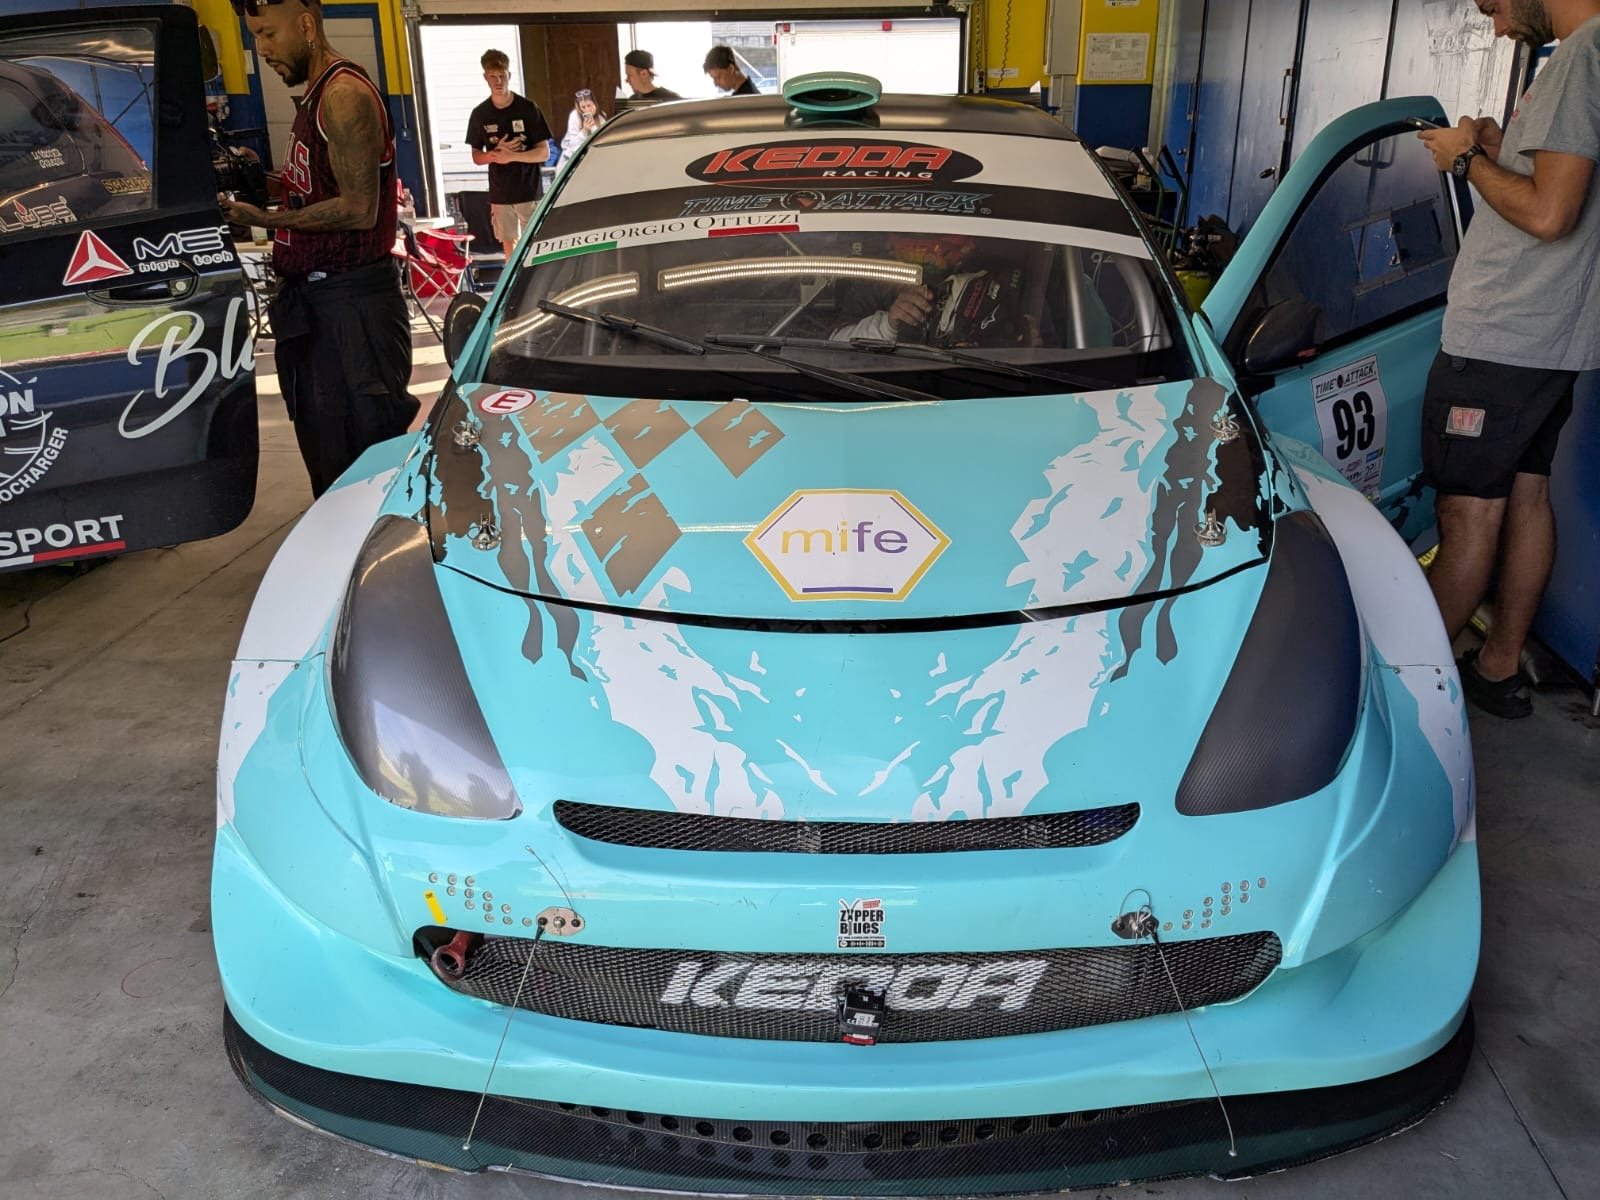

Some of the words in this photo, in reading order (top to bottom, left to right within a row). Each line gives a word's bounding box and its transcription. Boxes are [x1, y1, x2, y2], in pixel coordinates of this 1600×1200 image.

[702, 146, 952, 174] KEDDA
[822, 170, 933, 179] RACING
[679, 194, 785, 217] TIME
[820, 191, 992, 210] ATTACK
[535, 221, 685, 255] PIERGIORGIO
[692, 213, 799, 229] OTTUZZI
[138, 258, 180, 273] high
[193, 250, 234, 266] tech
[1315, 378, 1338, 396] TIME
[1344, 361, 1376, 385] ATTACK
[490, 392, 526, 410] E
[1332, 390, 1376, 461] 93
[781, 520, 908, 554] mife
